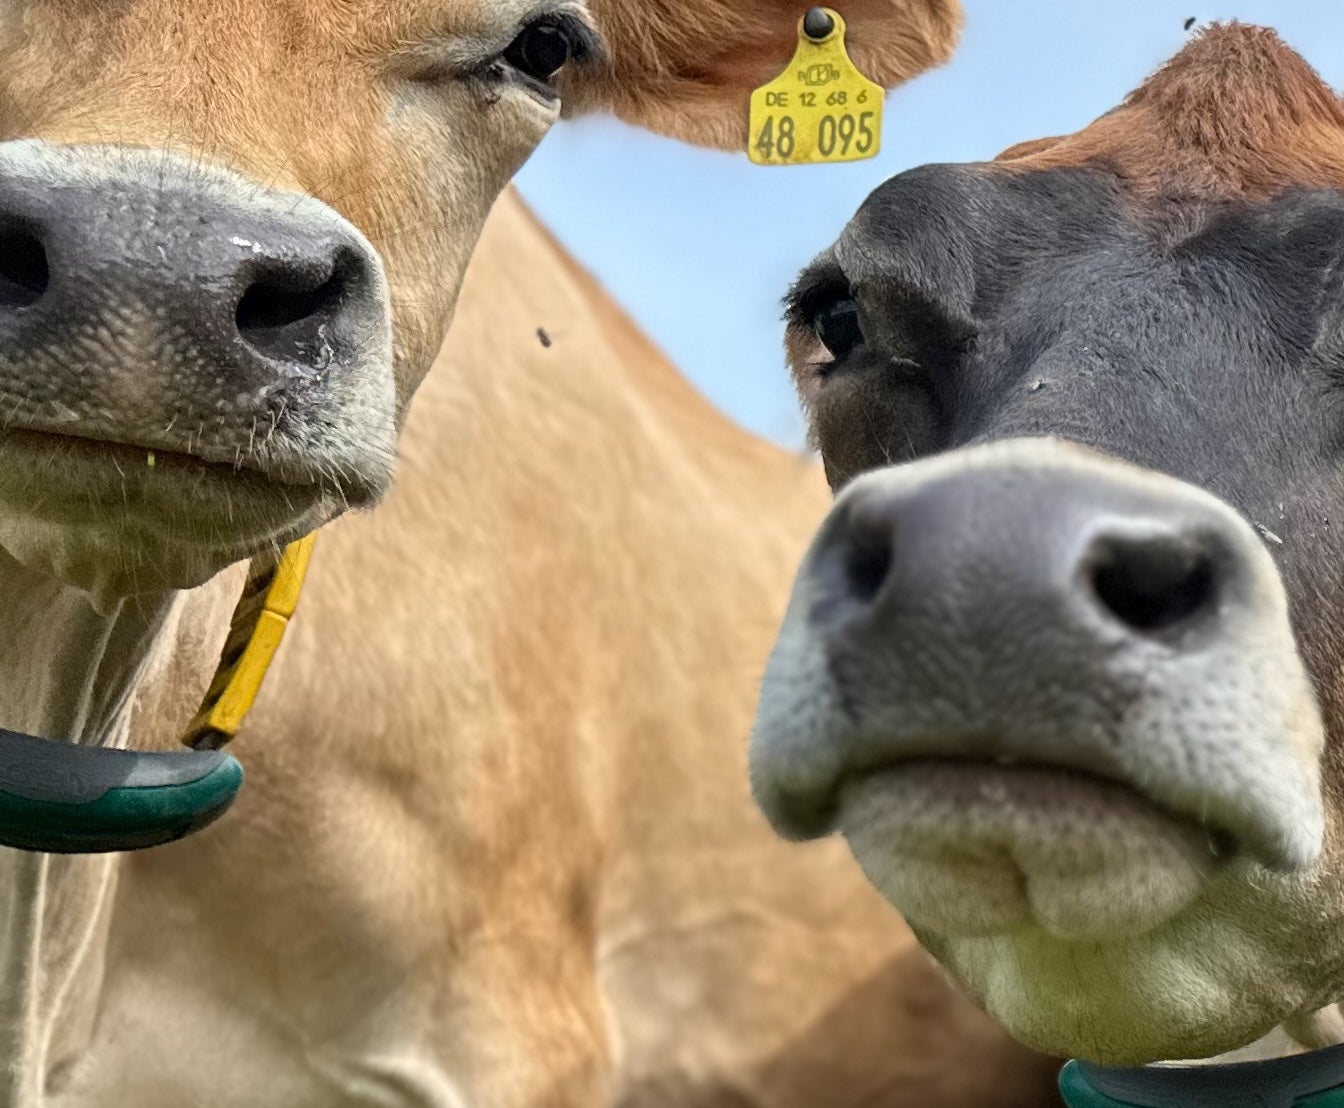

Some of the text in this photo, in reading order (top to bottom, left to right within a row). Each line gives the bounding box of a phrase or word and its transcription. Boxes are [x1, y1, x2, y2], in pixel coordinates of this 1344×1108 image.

[765, 90, 868, 107] DE 12 68 6
[754, 111, 874, 159] 48 095
